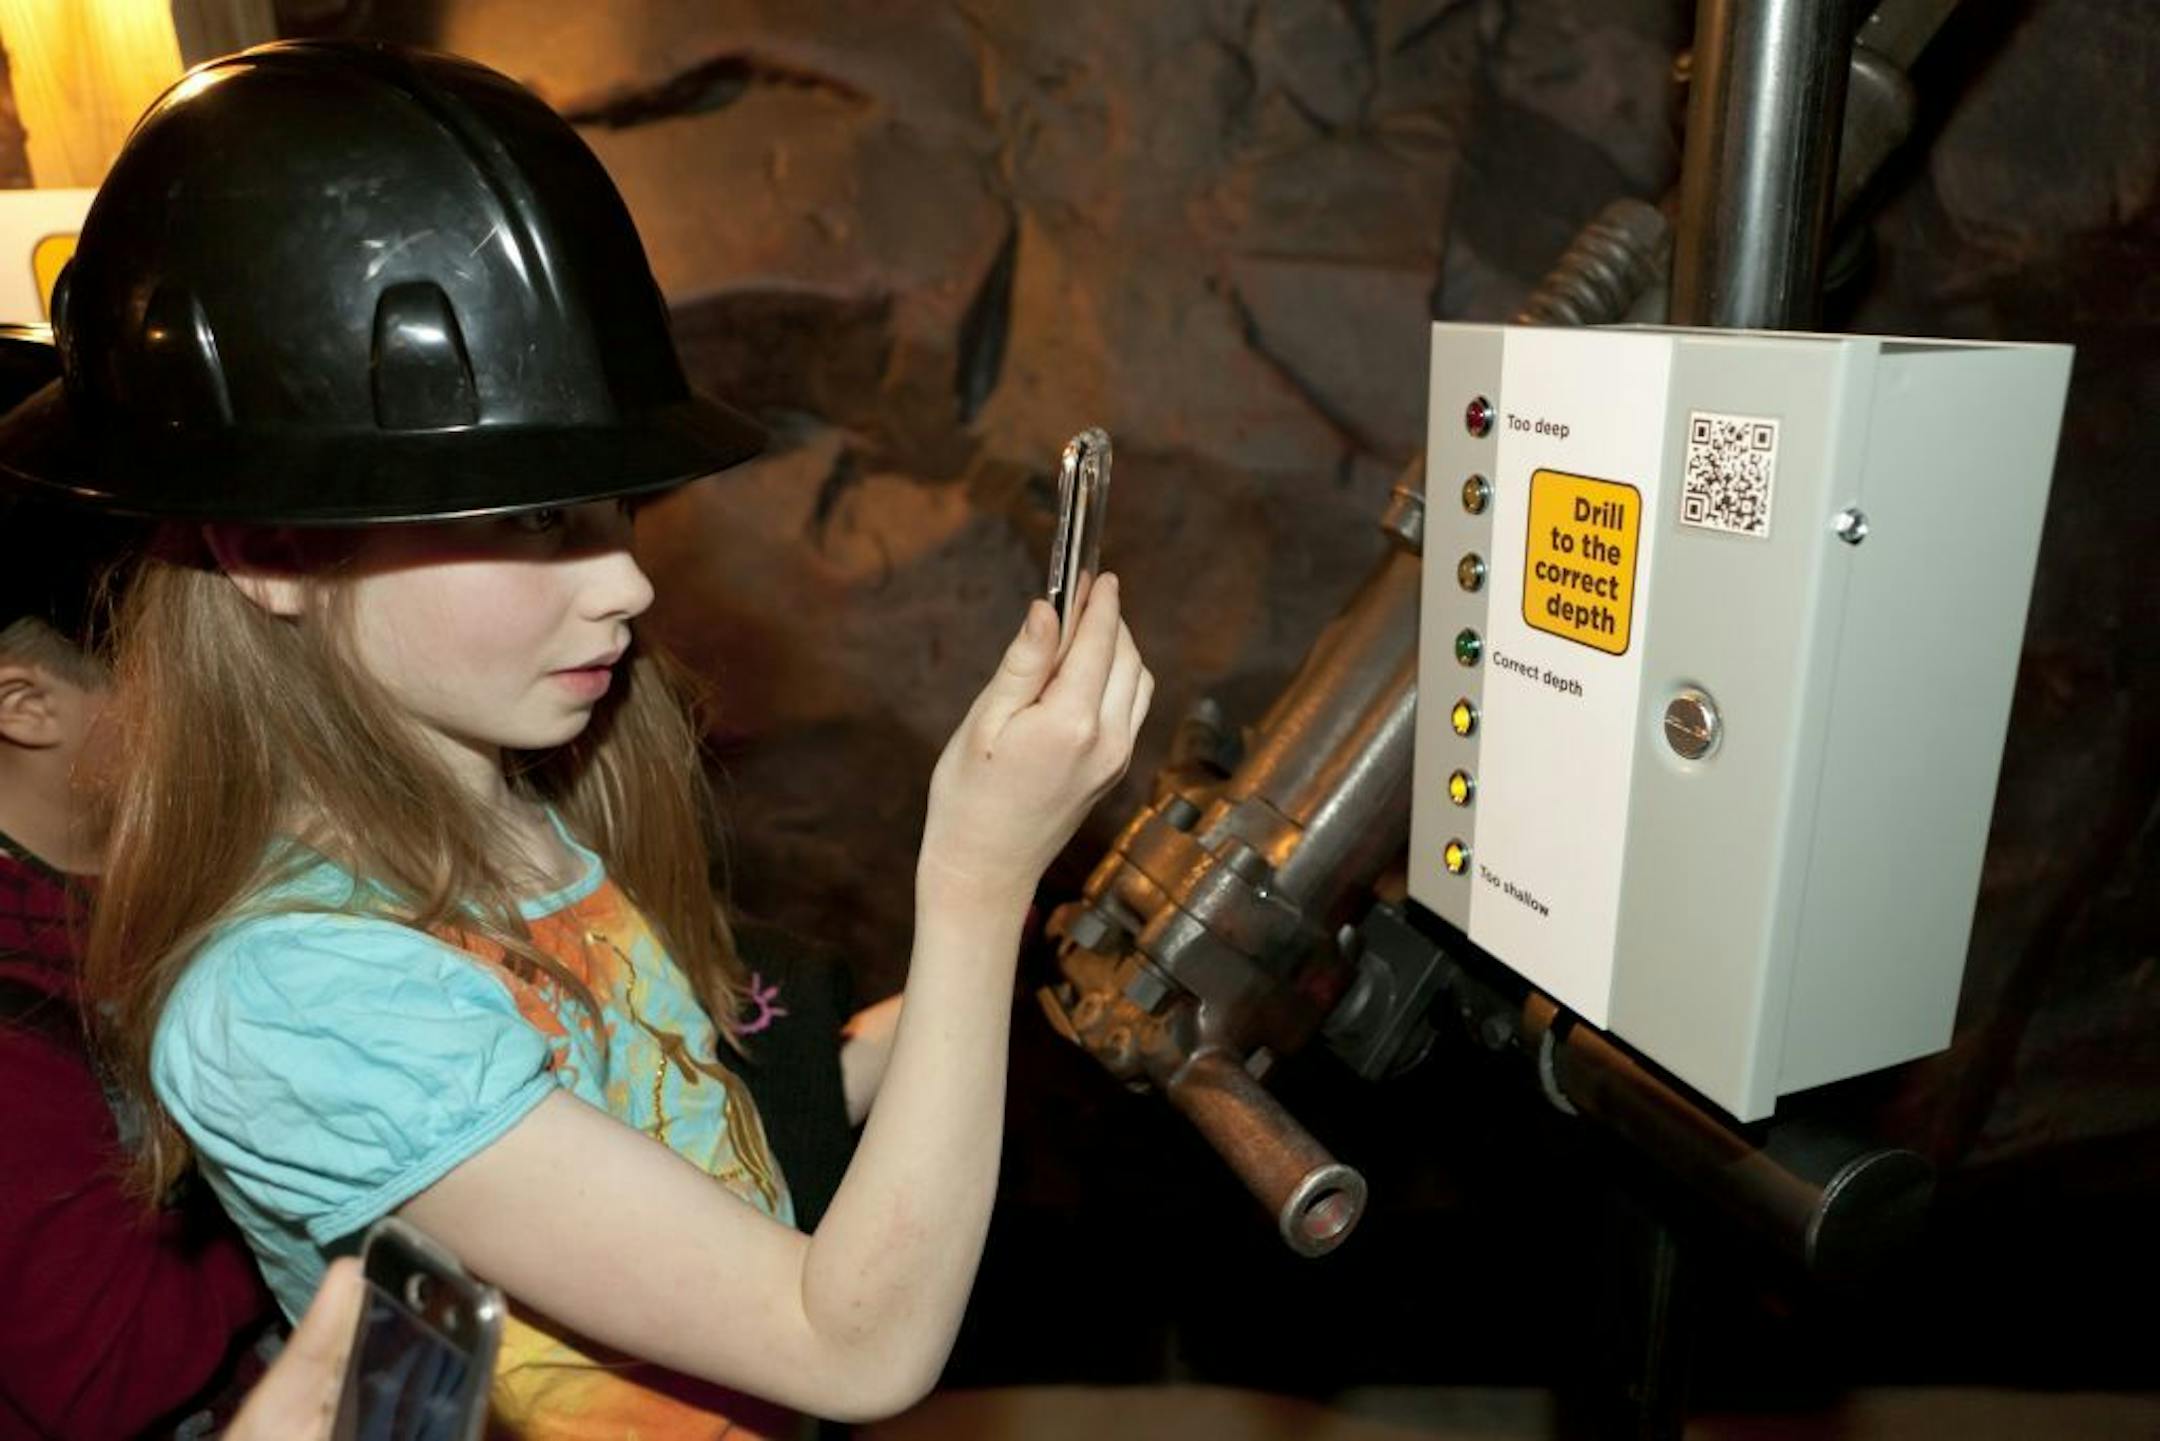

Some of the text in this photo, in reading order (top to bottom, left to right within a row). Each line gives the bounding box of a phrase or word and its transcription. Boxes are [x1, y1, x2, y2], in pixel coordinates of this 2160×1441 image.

[1508, 414, 1570, 440] Too deep
[1574, 496, 1624, 531] Drill
[1552, 526, 1621, 566] to the
[1535, 560, 1619, 601] correct
[1546, 593, 1615, 635] depth
[1493, 651, 1583, 697] Correct depth
[1480, 864, 1549, 917] Too shallow
